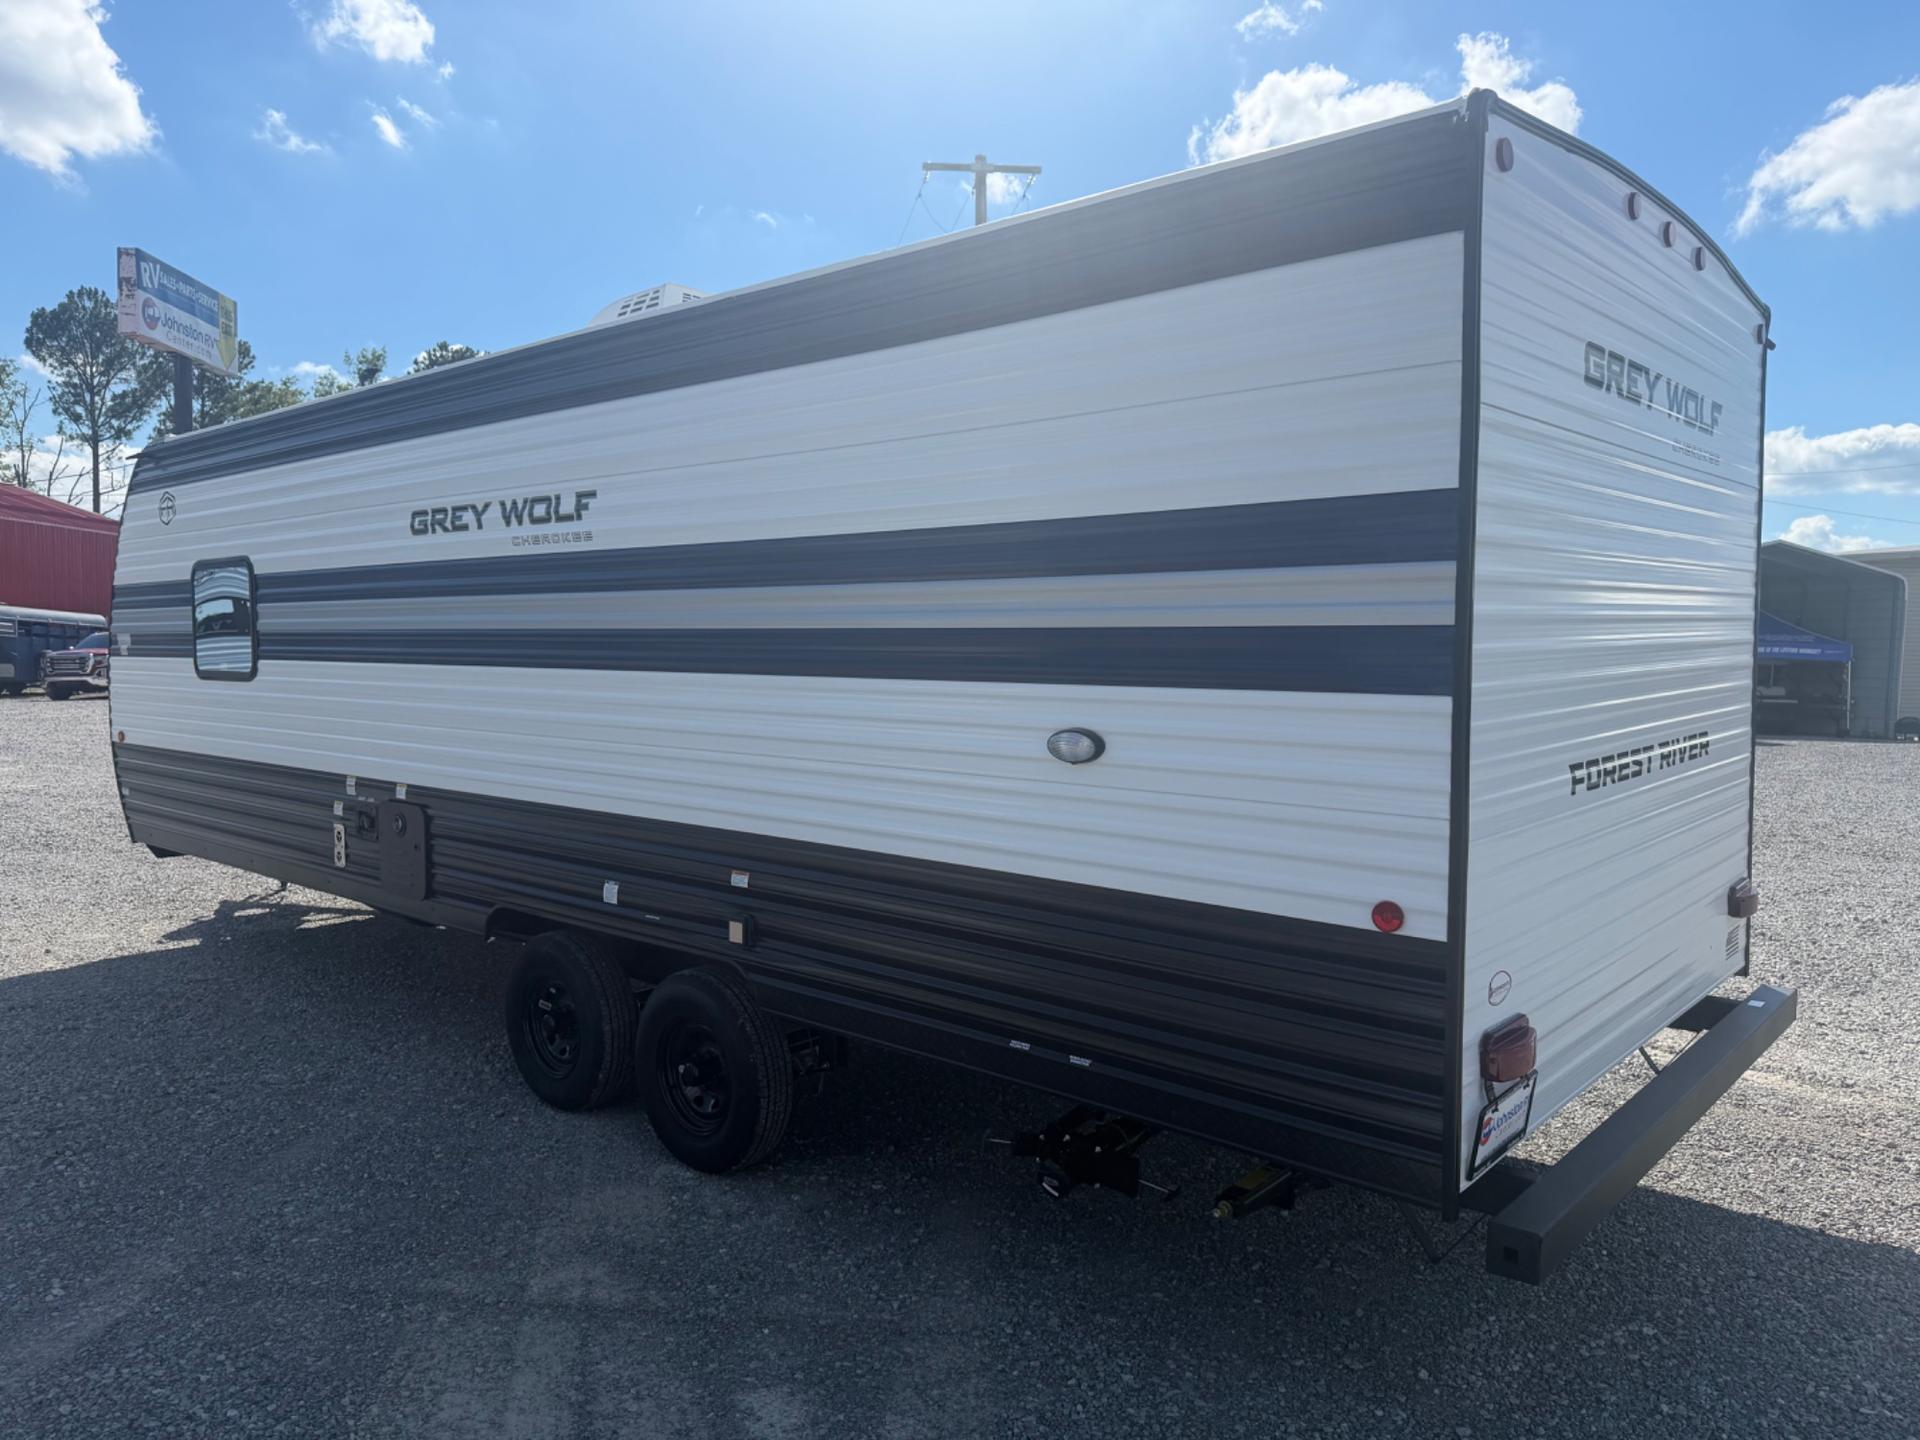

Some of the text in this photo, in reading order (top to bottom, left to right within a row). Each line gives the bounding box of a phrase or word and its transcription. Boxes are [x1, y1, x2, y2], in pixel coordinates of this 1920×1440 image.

[140, 262, 160, 289] RV
[161, 311, 204, 344] Johnston
[1584, 340, 1723, 436] GREY WOLF
[410, 490, 597, 536] GREY WOLF
[511, 530, 594, 547] CHEROKEE
[1569, 731, 1711, 796] FOREST RIVER
